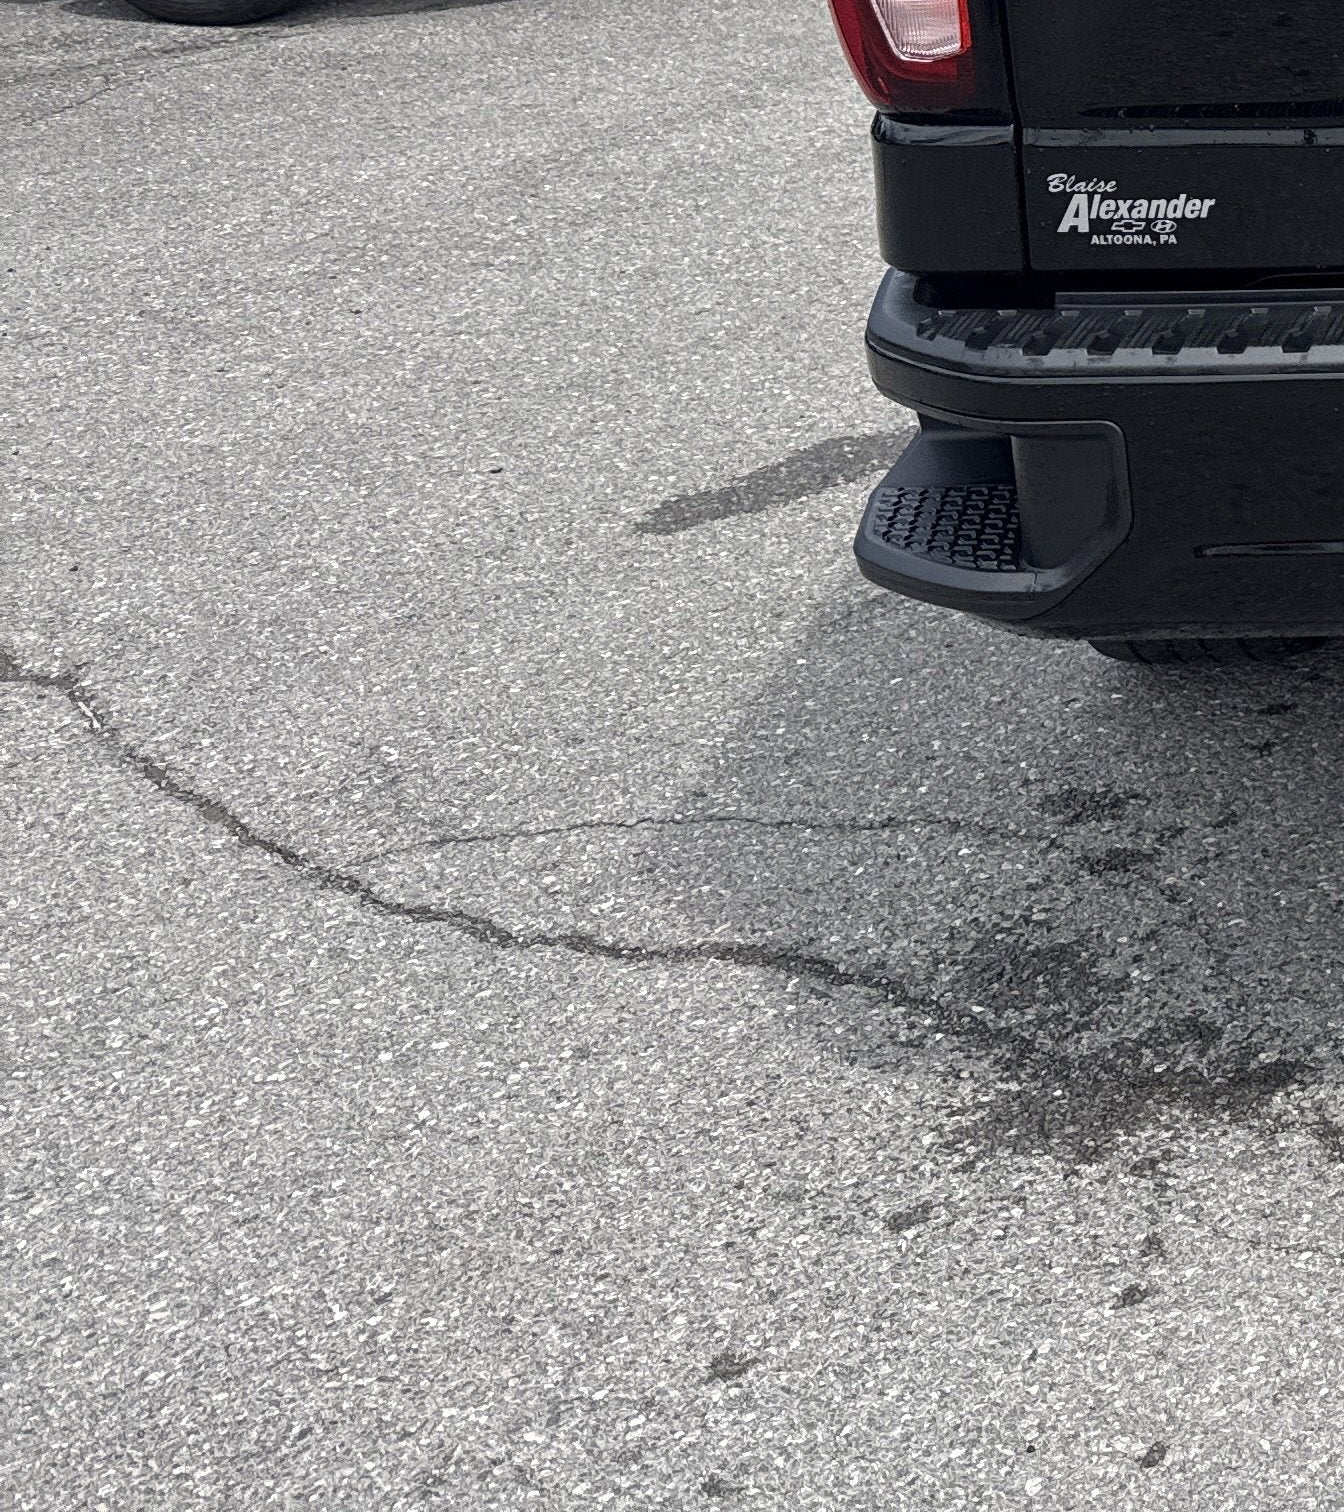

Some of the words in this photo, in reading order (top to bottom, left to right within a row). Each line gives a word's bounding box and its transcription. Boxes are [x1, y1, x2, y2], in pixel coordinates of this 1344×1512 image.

[1046, 173, 1118, 193] Blaise
[1056, 193, 1216, 233] Alexander
[1090, 234, 1157, 246] ALTOONA,
[1160, 235, 1178, 245] PA
